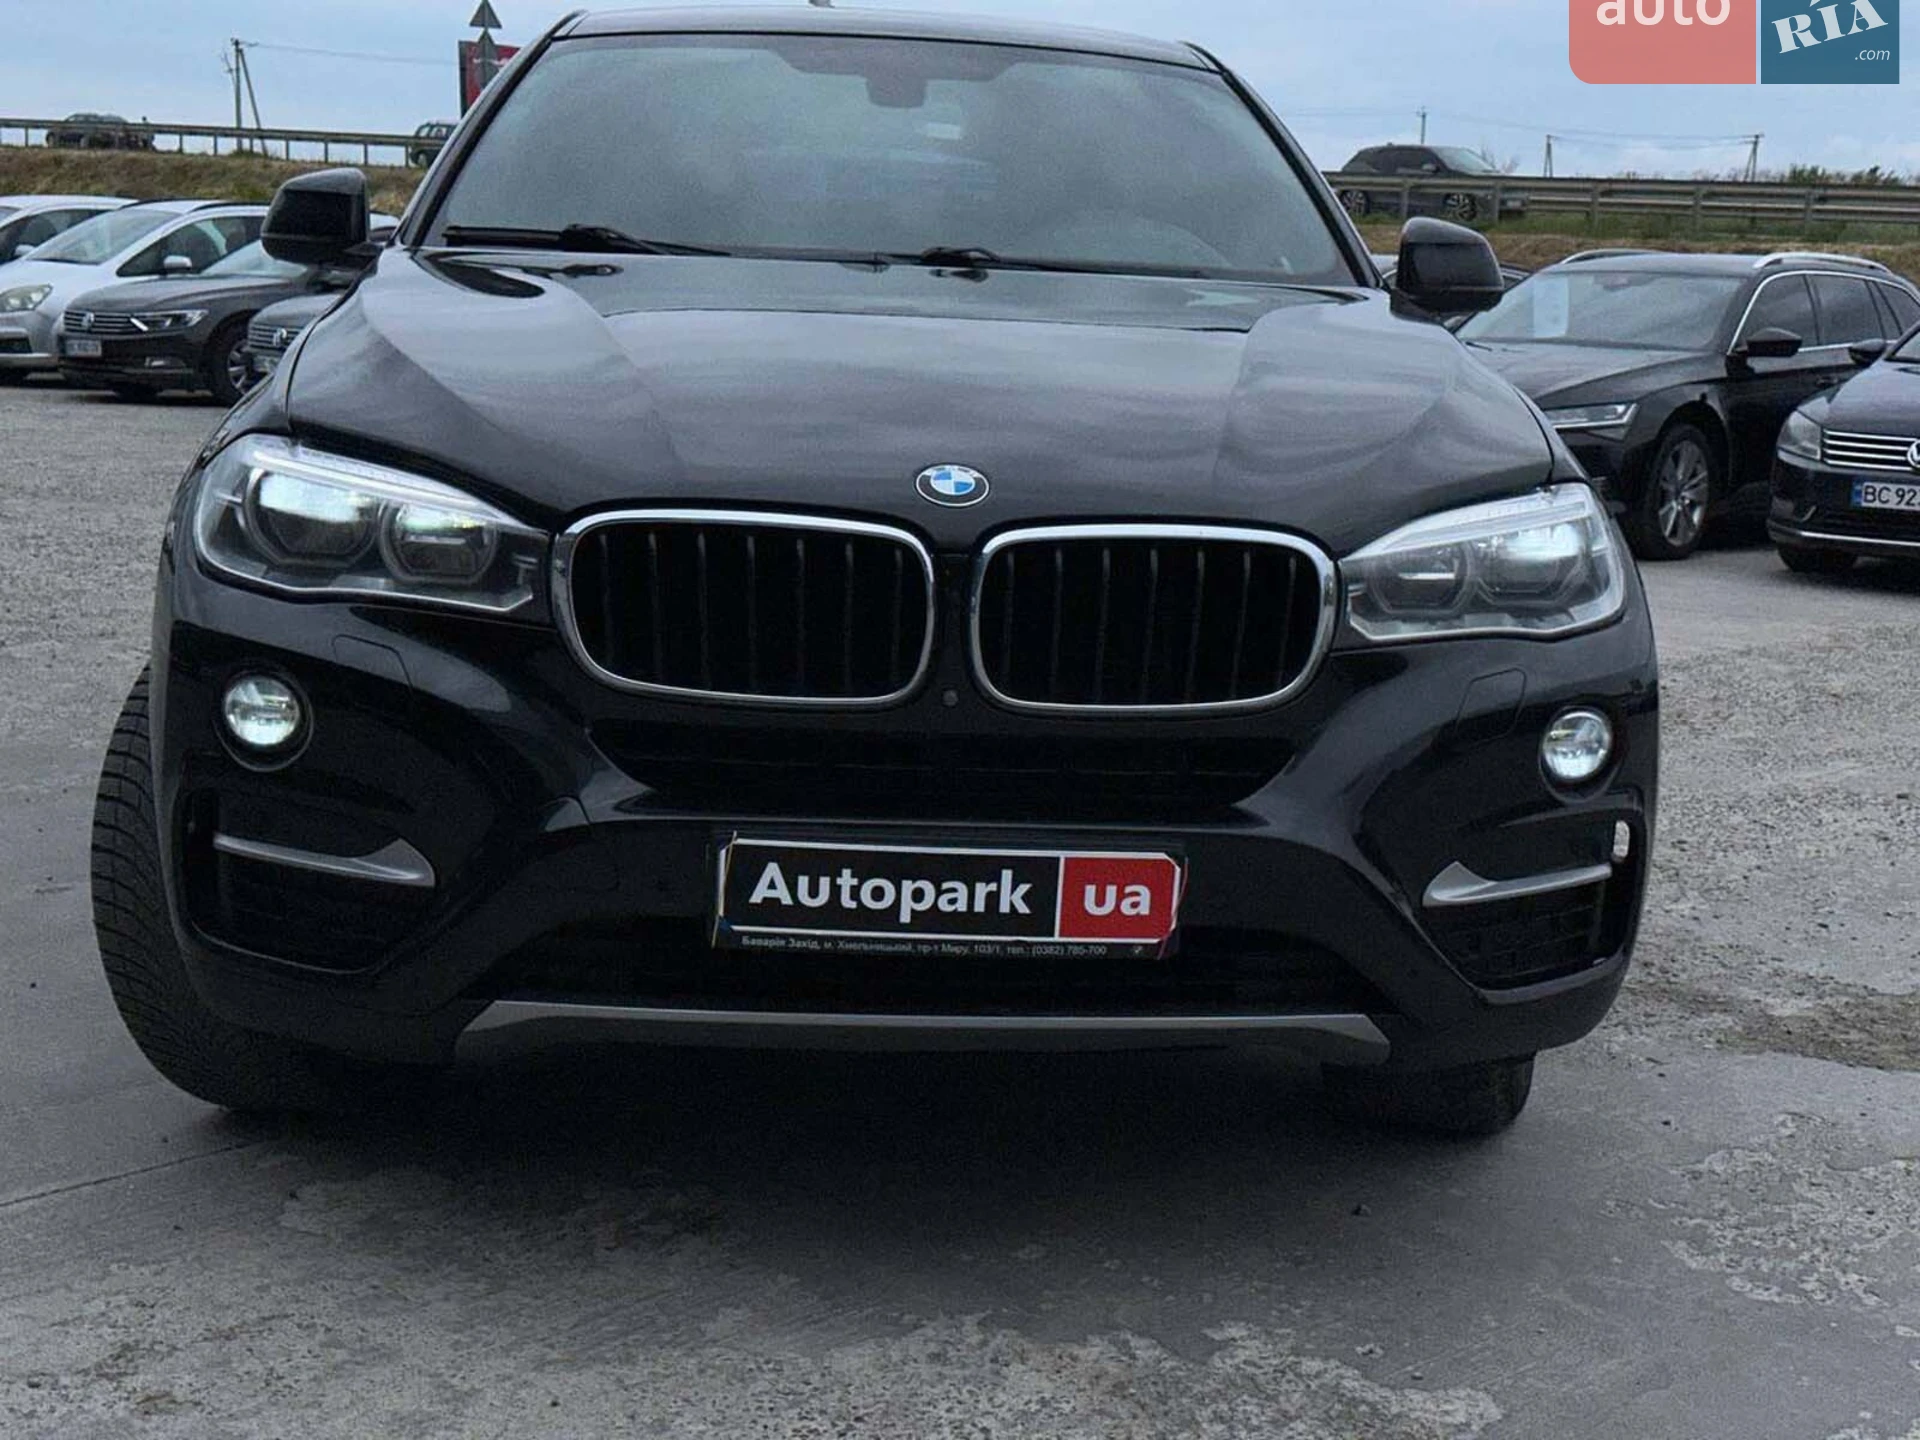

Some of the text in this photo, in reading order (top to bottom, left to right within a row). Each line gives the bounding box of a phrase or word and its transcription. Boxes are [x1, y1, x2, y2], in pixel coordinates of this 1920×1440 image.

[1864, 485, 1920, 507] BC 92
[748, 861, 1153, 924] Autopark ua
